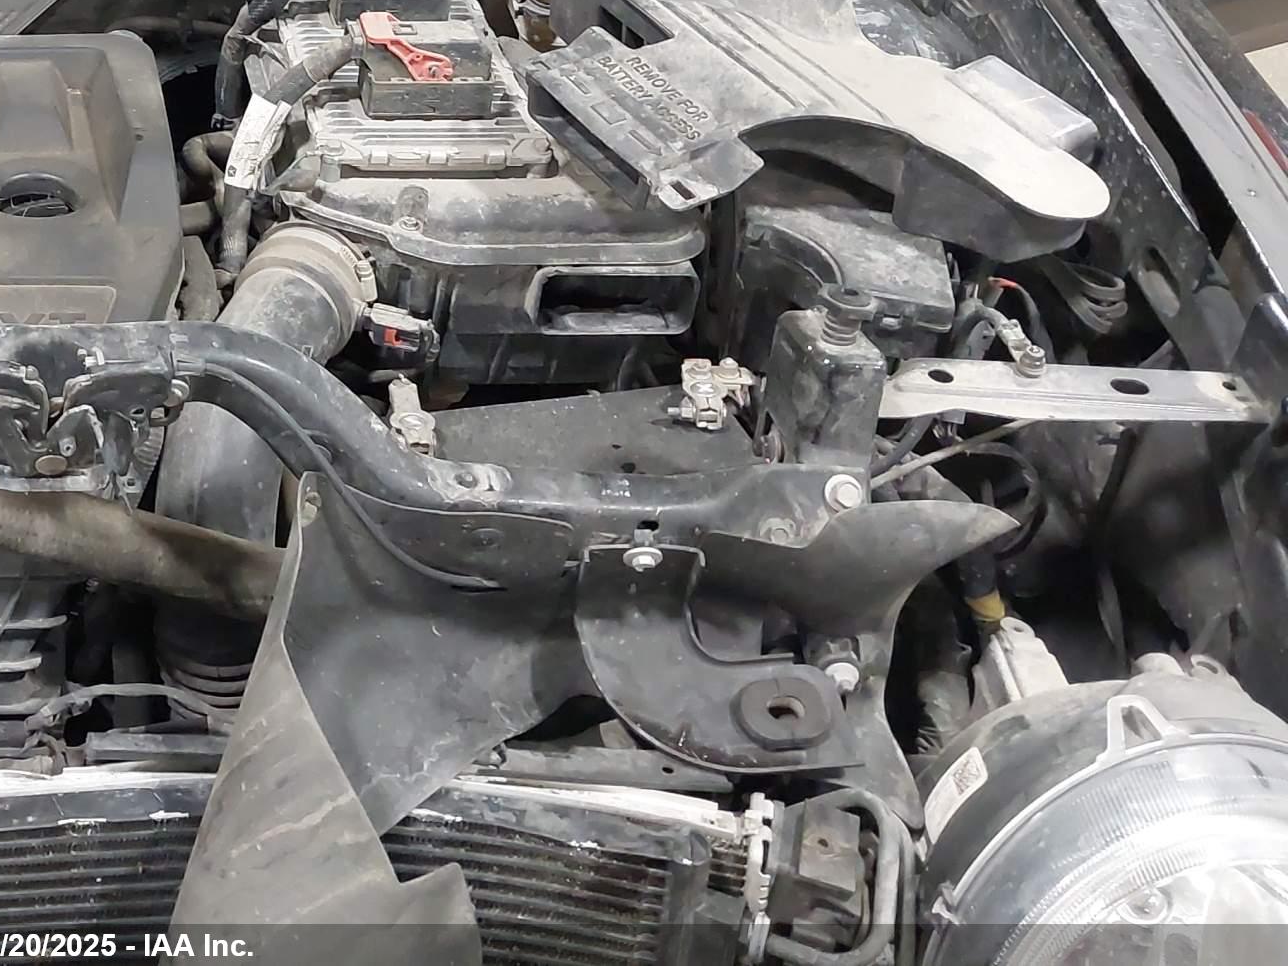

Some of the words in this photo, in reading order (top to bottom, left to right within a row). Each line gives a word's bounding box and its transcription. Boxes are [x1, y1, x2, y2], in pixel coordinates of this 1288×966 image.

[597, 56, 653, 99] BATTERY
[645, 100, 702, 141] ACCESS
[626, 56, 684, 101] REMOVE
[677, 99, 709, 122] FOR
